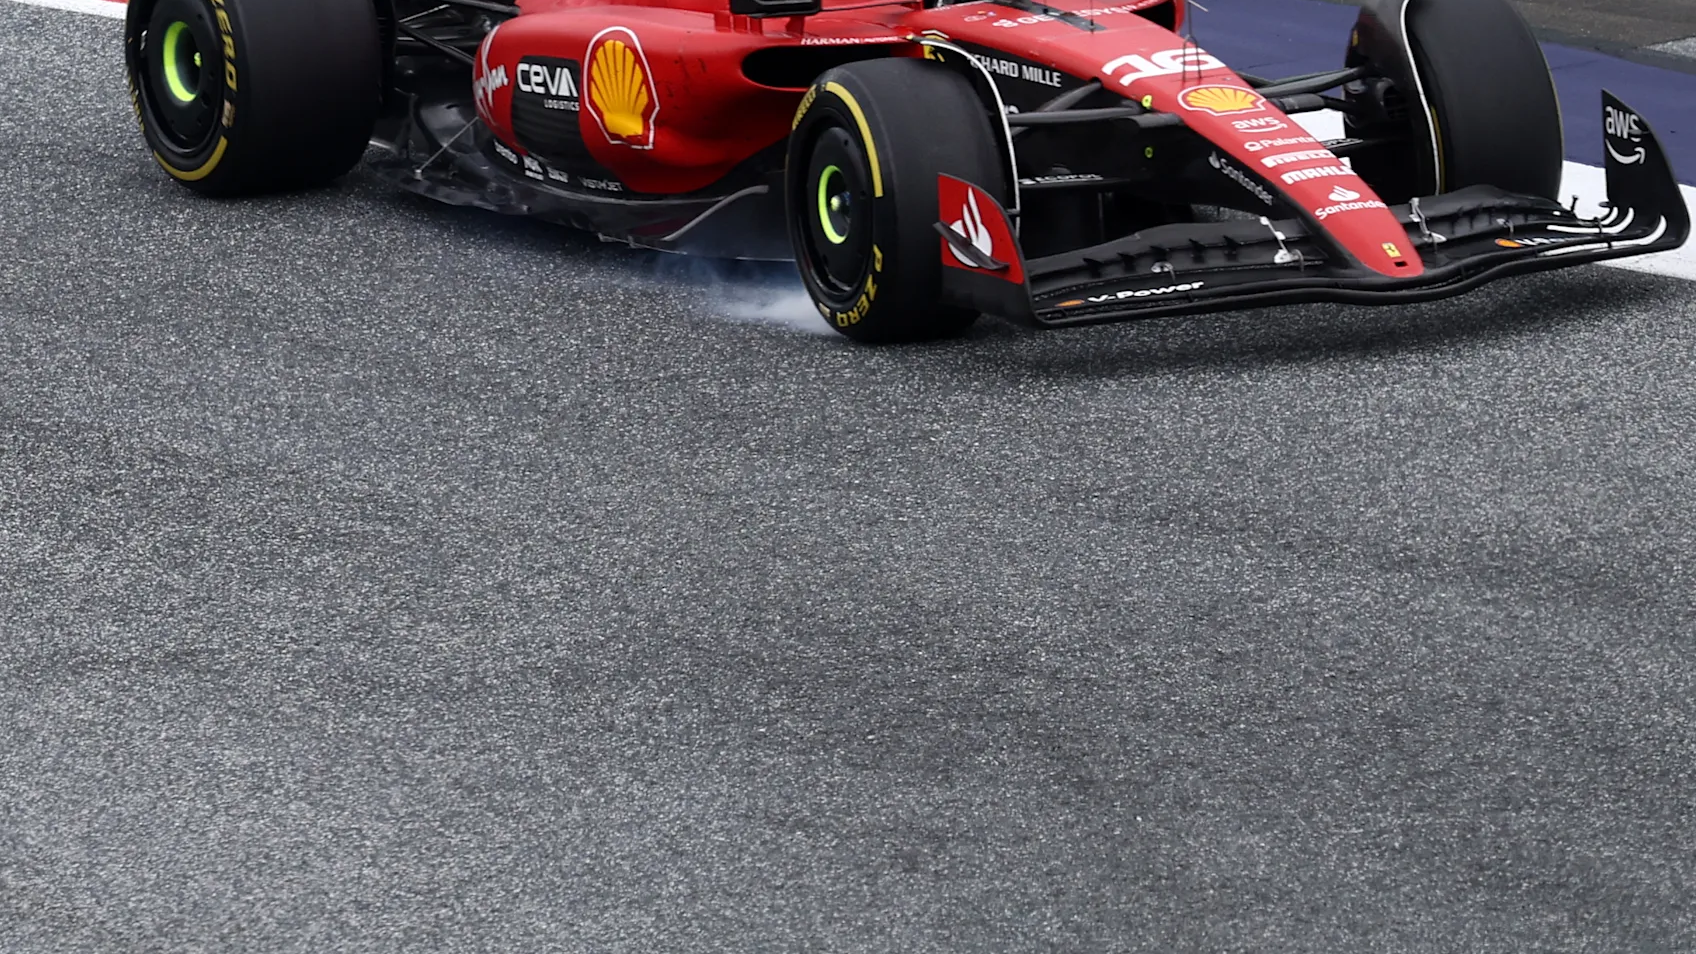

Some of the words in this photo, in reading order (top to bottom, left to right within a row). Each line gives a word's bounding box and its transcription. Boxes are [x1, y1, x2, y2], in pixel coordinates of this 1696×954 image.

[800, 37, 860, 46] HARMAN
[1021, 64, 1062, 88] MILLE
[1101, 48, 1227, 87] 16
[1232, 116, 1281, 129] aws
[1605, 106, 1642, 142] aws
[836, 273, 878, 328] ZERO
[1088, 282, 1204, 302] V-Power
